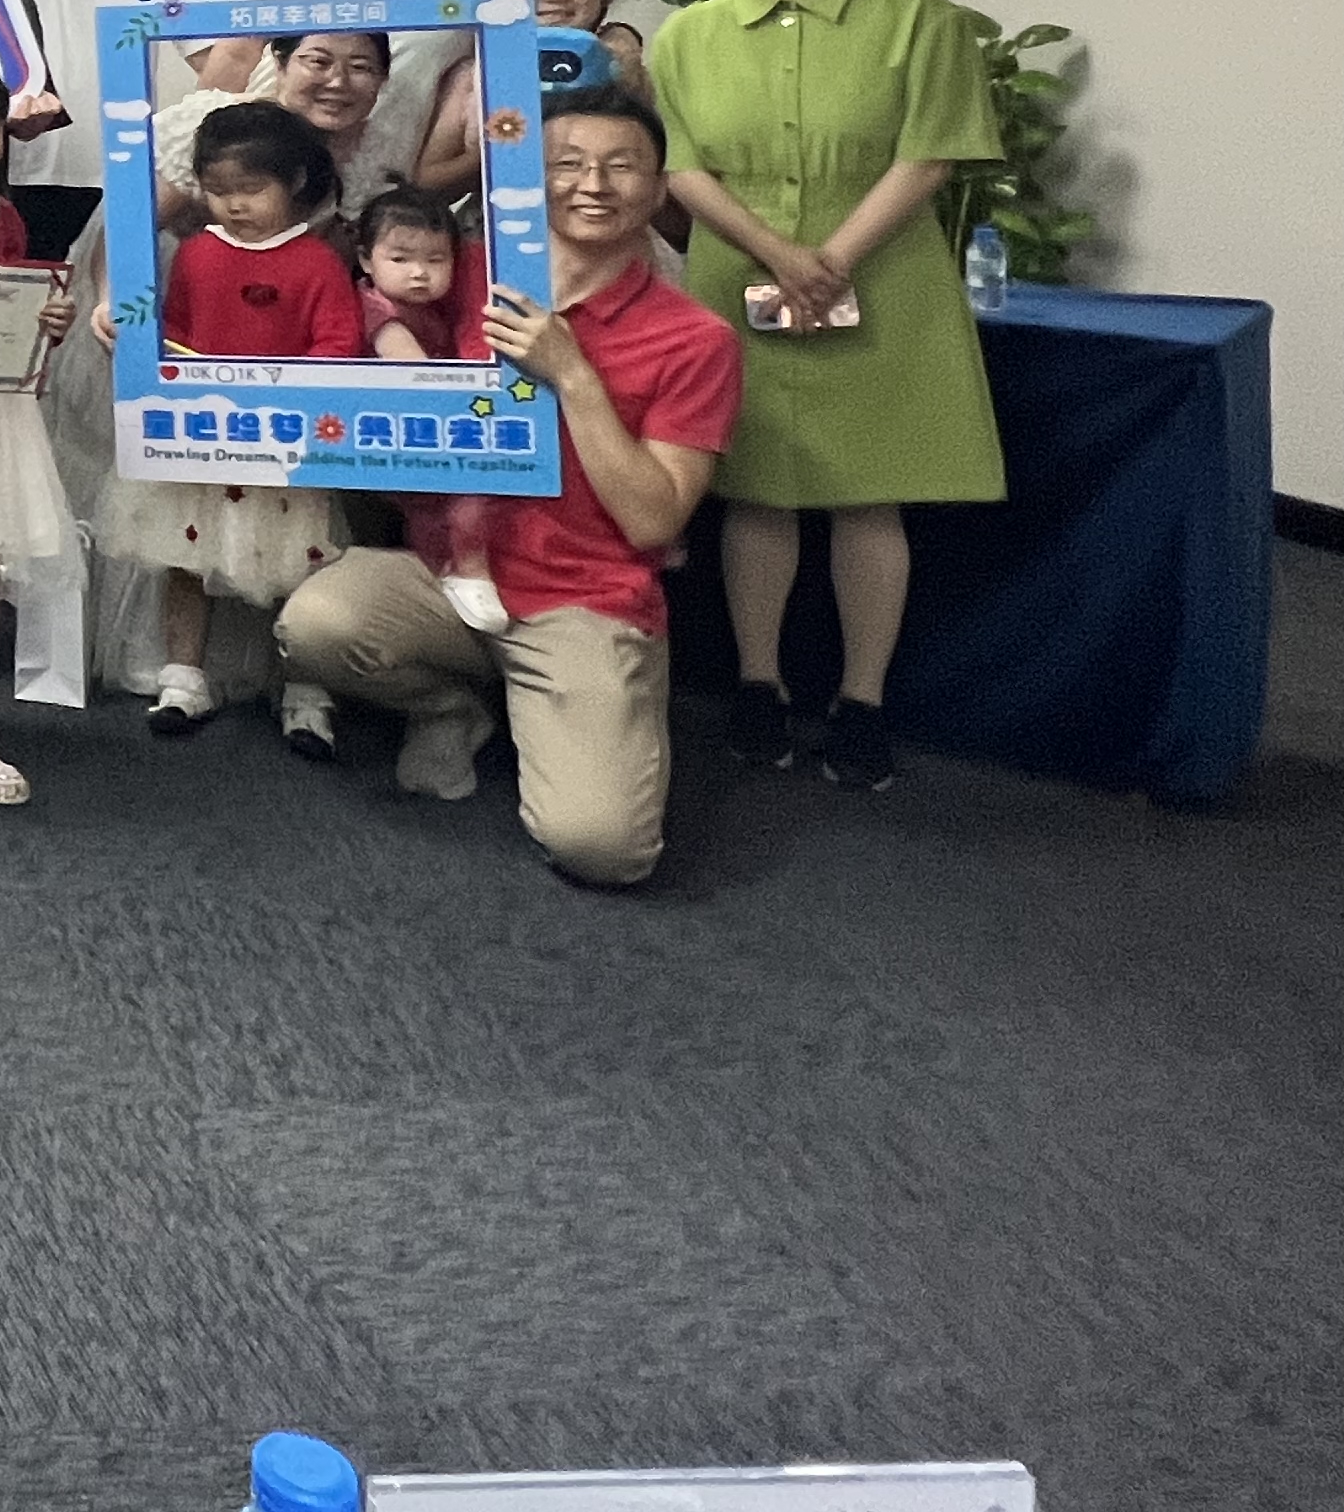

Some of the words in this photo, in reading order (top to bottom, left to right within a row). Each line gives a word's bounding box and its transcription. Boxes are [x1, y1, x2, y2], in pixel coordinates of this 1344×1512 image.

[230, 1, 387, 28] 拓展幸福空间
[183, 365, 213, 381] 10K
[237, 367, 257, 381] 1K
[144, 446, 210, 462] Drawing
